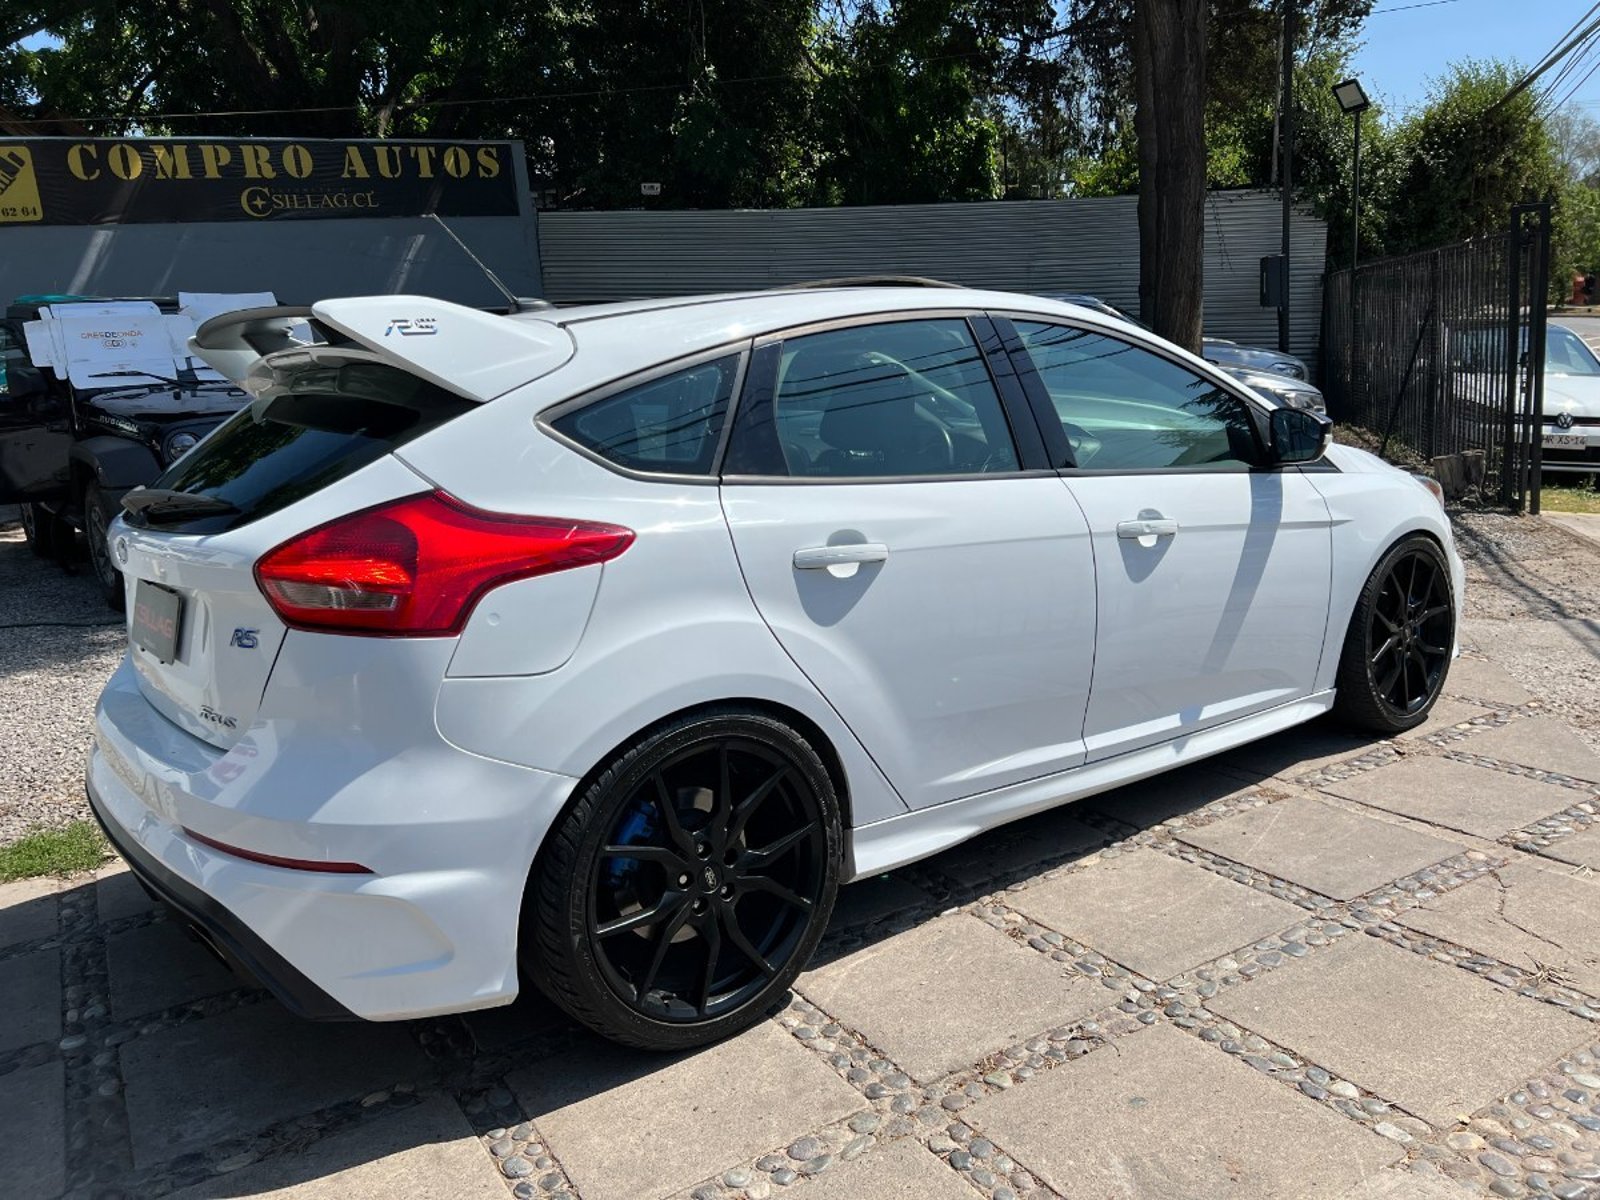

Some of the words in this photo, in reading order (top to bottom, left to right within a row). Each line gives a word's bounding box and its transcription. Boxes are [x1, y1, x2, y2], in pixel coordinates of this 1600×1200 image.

[67, 144, 314, 181] COMPRO
[341, 145, 501, 179] AUTOS
[230, 627, 260, 649] RS
